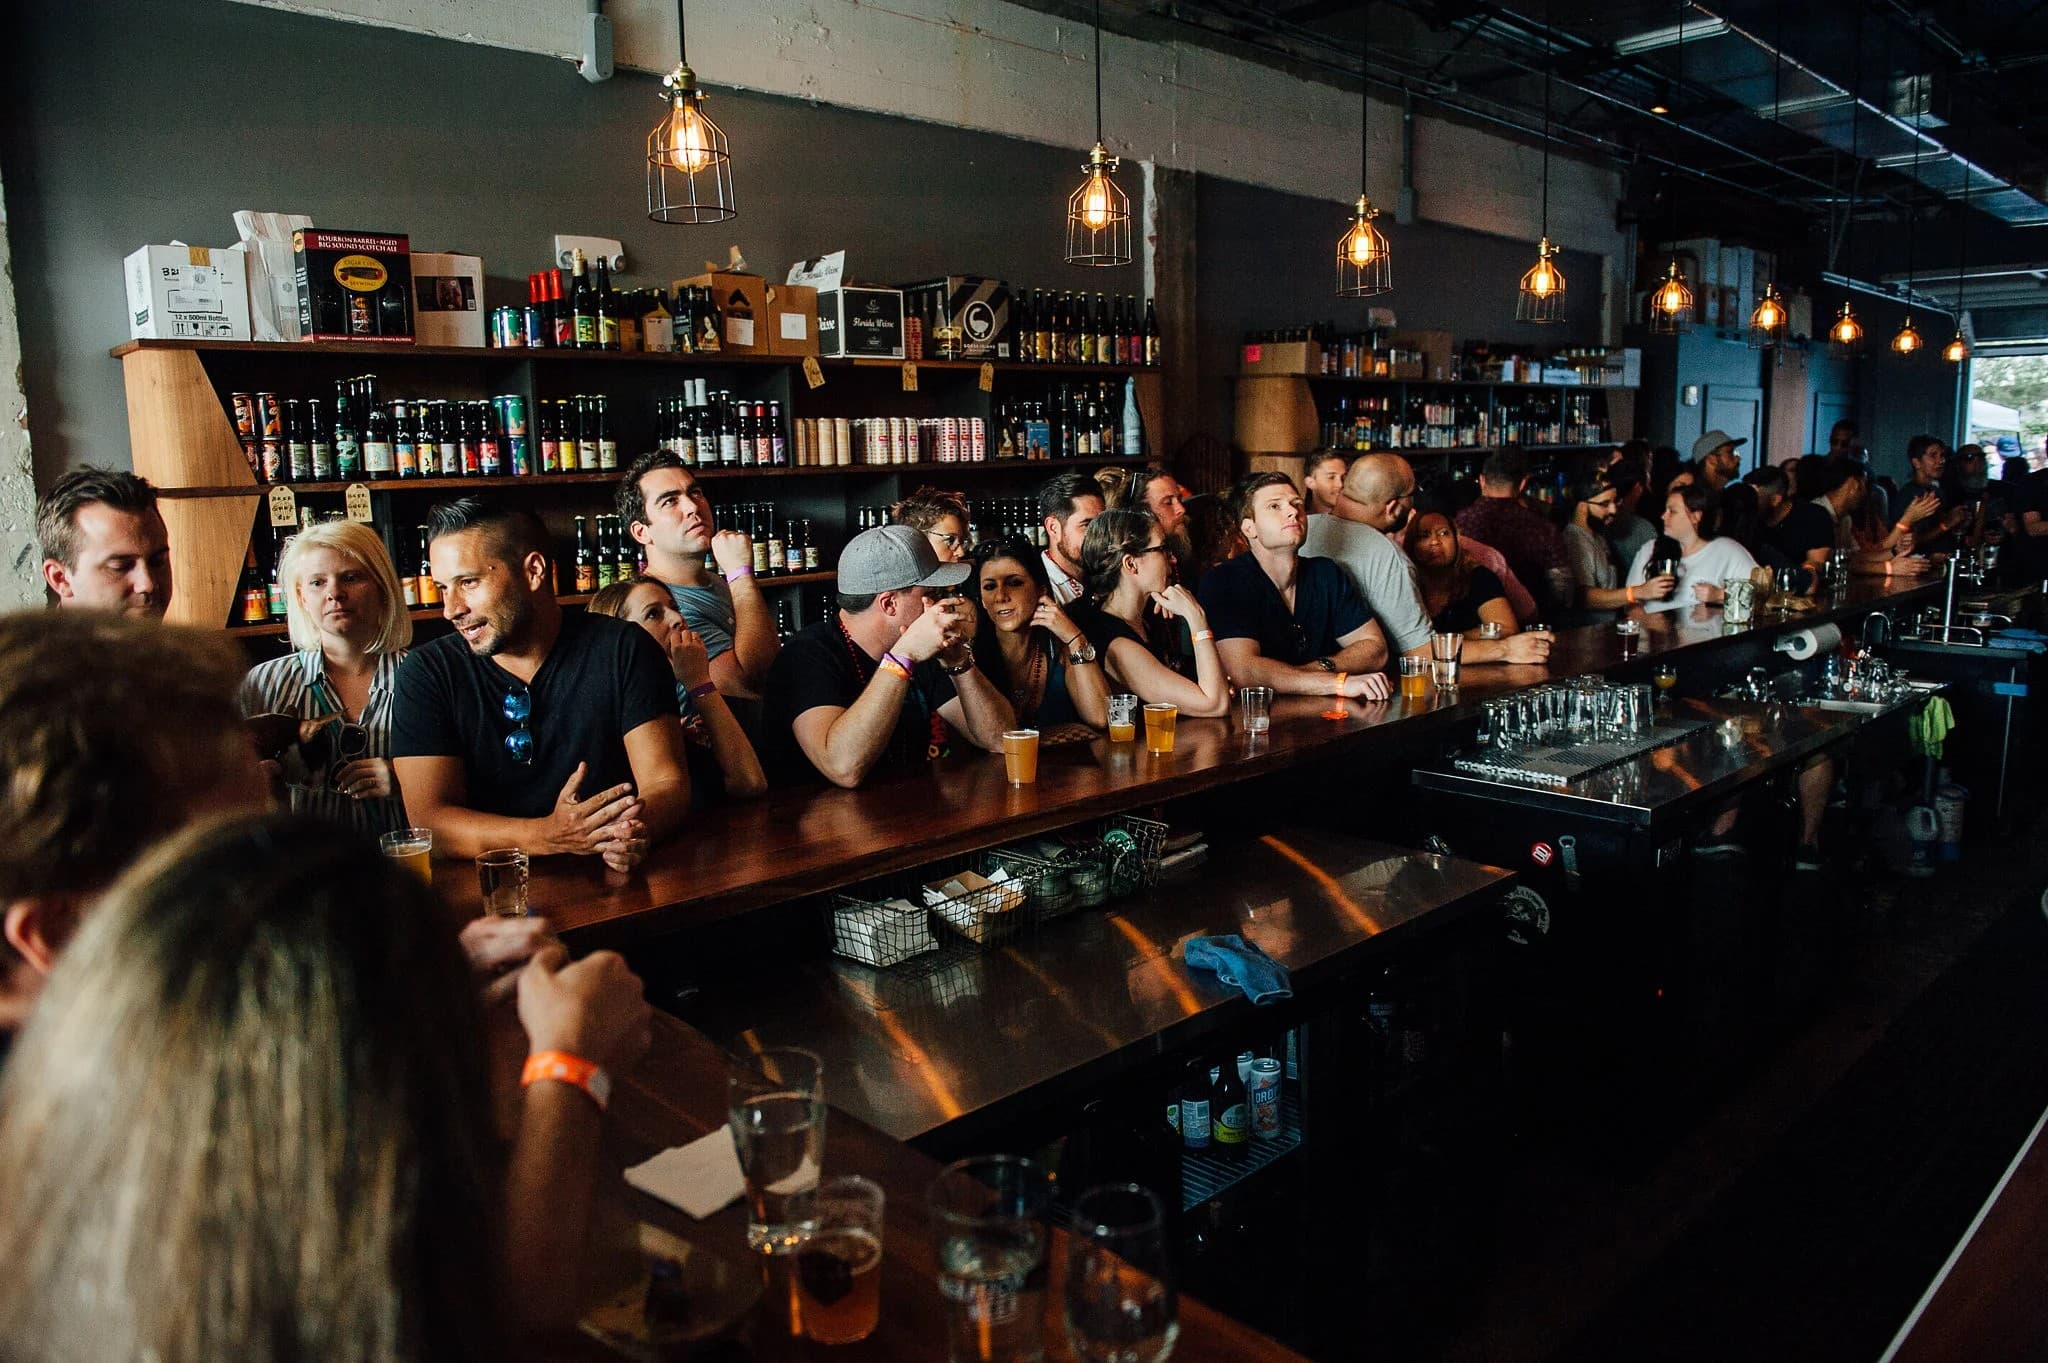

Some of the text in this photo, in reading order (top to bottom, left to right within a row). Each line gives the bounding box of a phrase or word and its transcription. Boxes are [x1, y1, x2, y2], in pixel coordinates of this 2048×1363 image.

[318, 235, 352, 243] BOURBON
[318, 241, 331, 249] BIG
[332, 242, 358, 250] SOUND
[358, 243, 385, 252] SCOTCH
[853, 317, 876, 328] Florida
